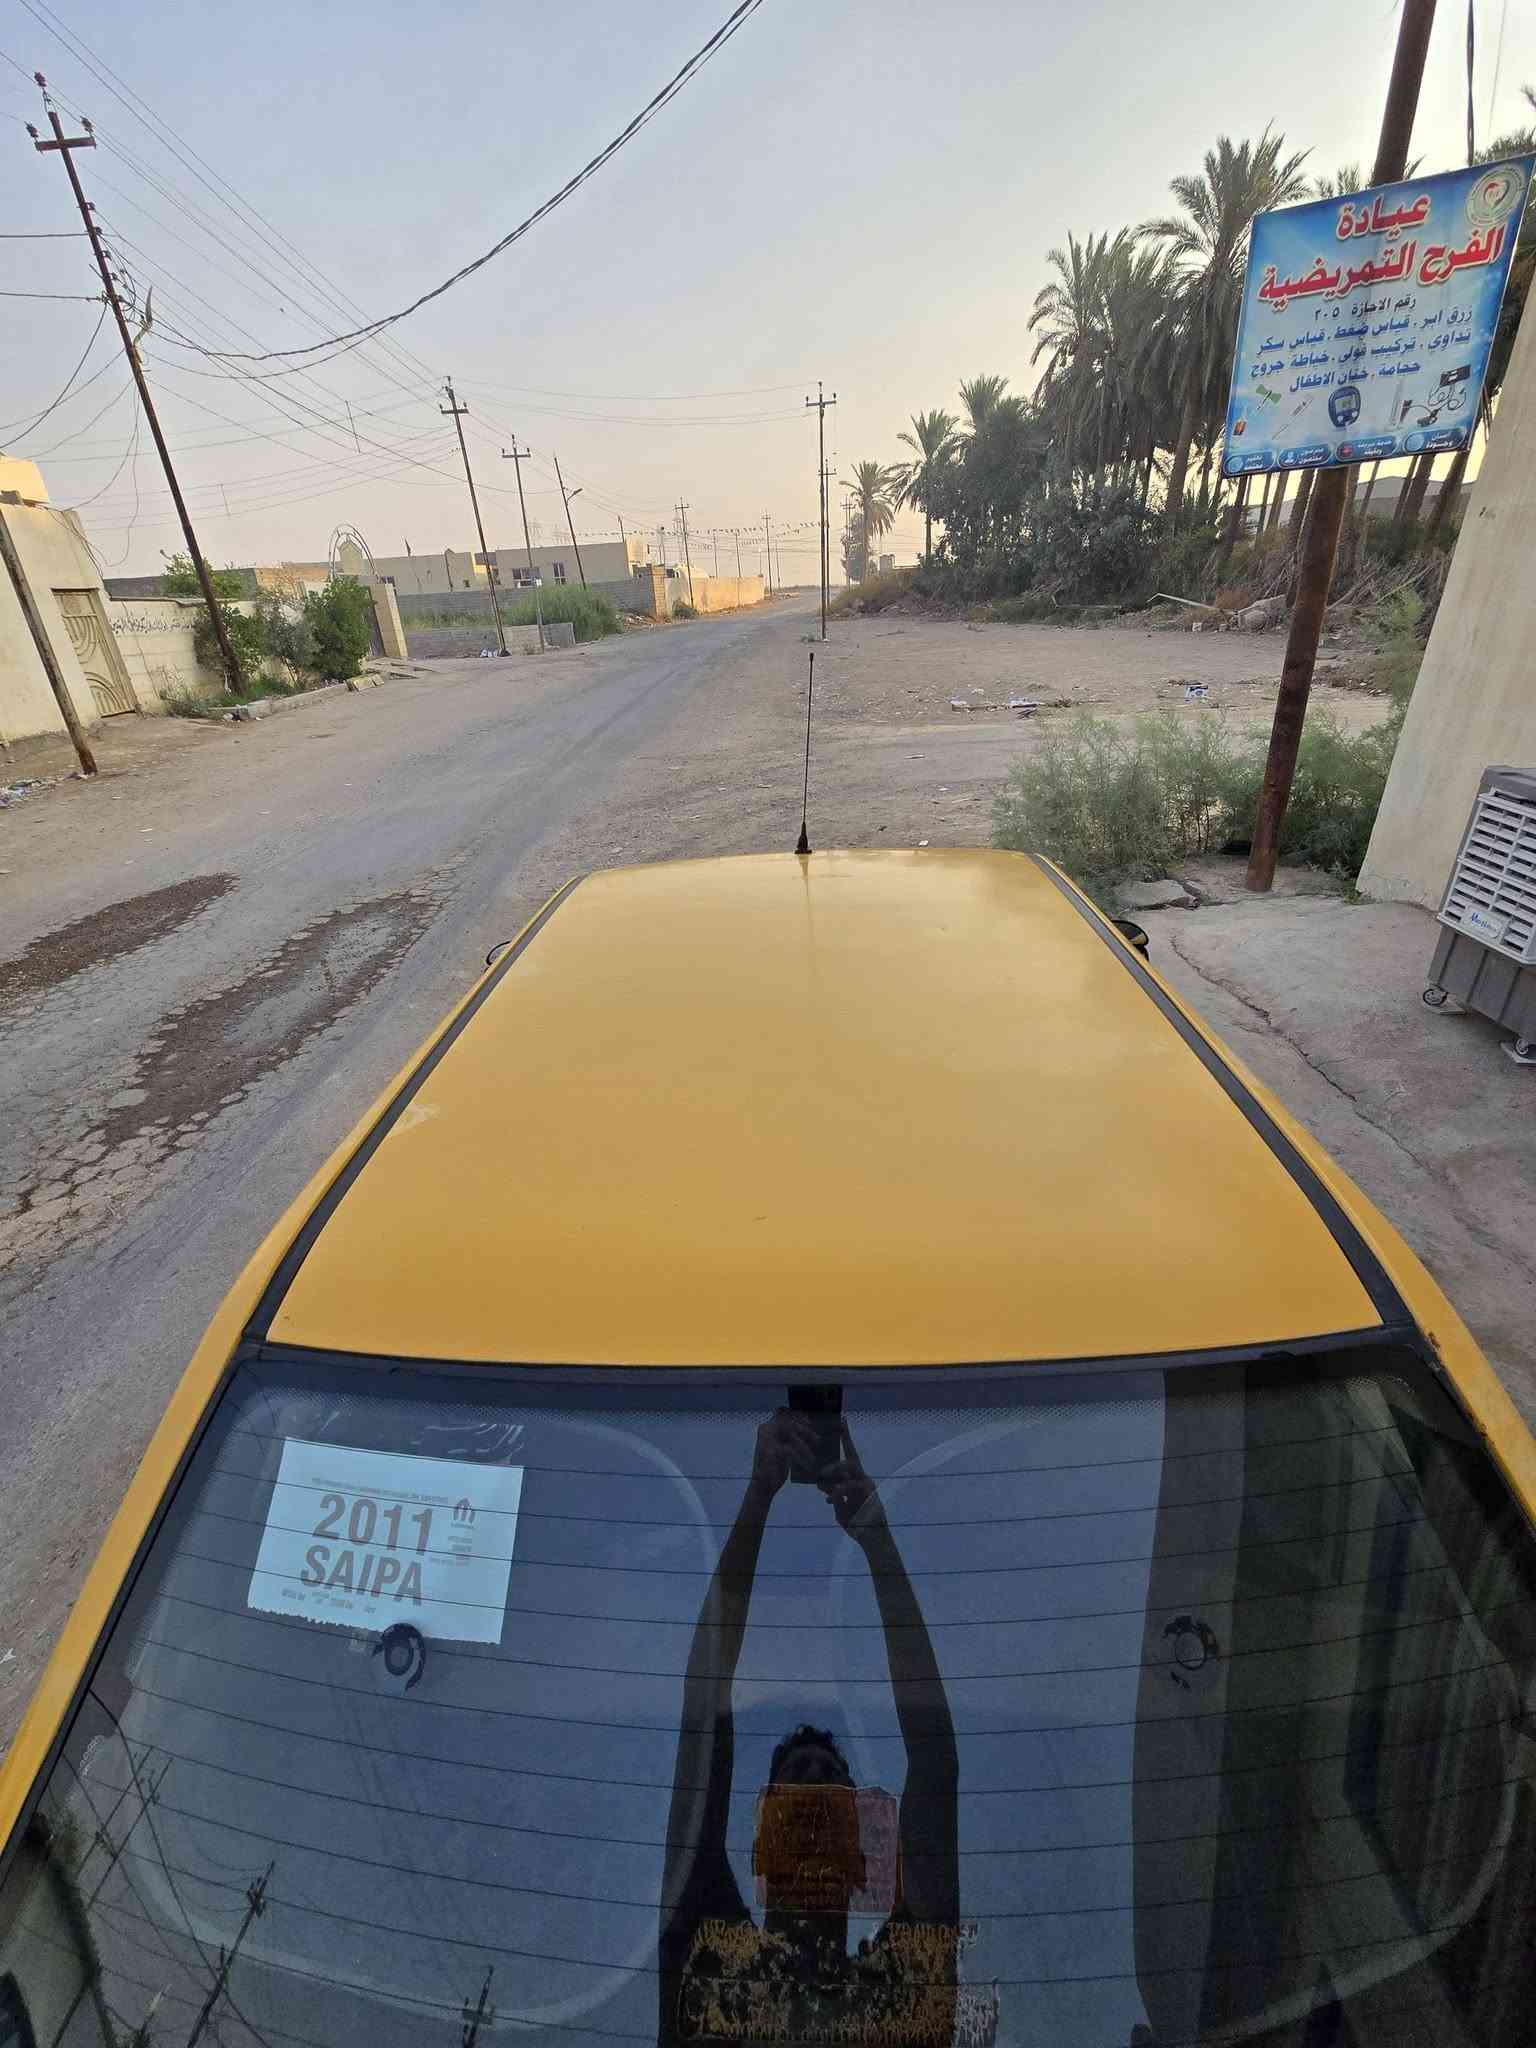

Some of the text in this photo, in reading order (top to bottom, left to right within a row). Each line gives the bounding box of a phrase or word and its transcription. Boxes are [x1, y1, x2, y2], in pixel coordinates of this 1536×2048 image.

[1336, 194, 1430, 241] عيادة
[1257, 224, 1506, 313] الفرح التمريضية
[1394, 294, 1416, 312] رقم
[1334, 320, 1369, 343] ضغط
[1372, 314, 1410, 336] قياس
[1256, 335, 1285, 356] سكر
[1288, 328, 1326, 349] قياس
[1251, 360, 1284, 378] جروح
[1290, 350, 1329, 368] خياطة
[1289, 371, 1335, 393] الاطفال
[313, 1494, 433, 1556] 2011
[300, 1545, 422, 1606] SAIPA
